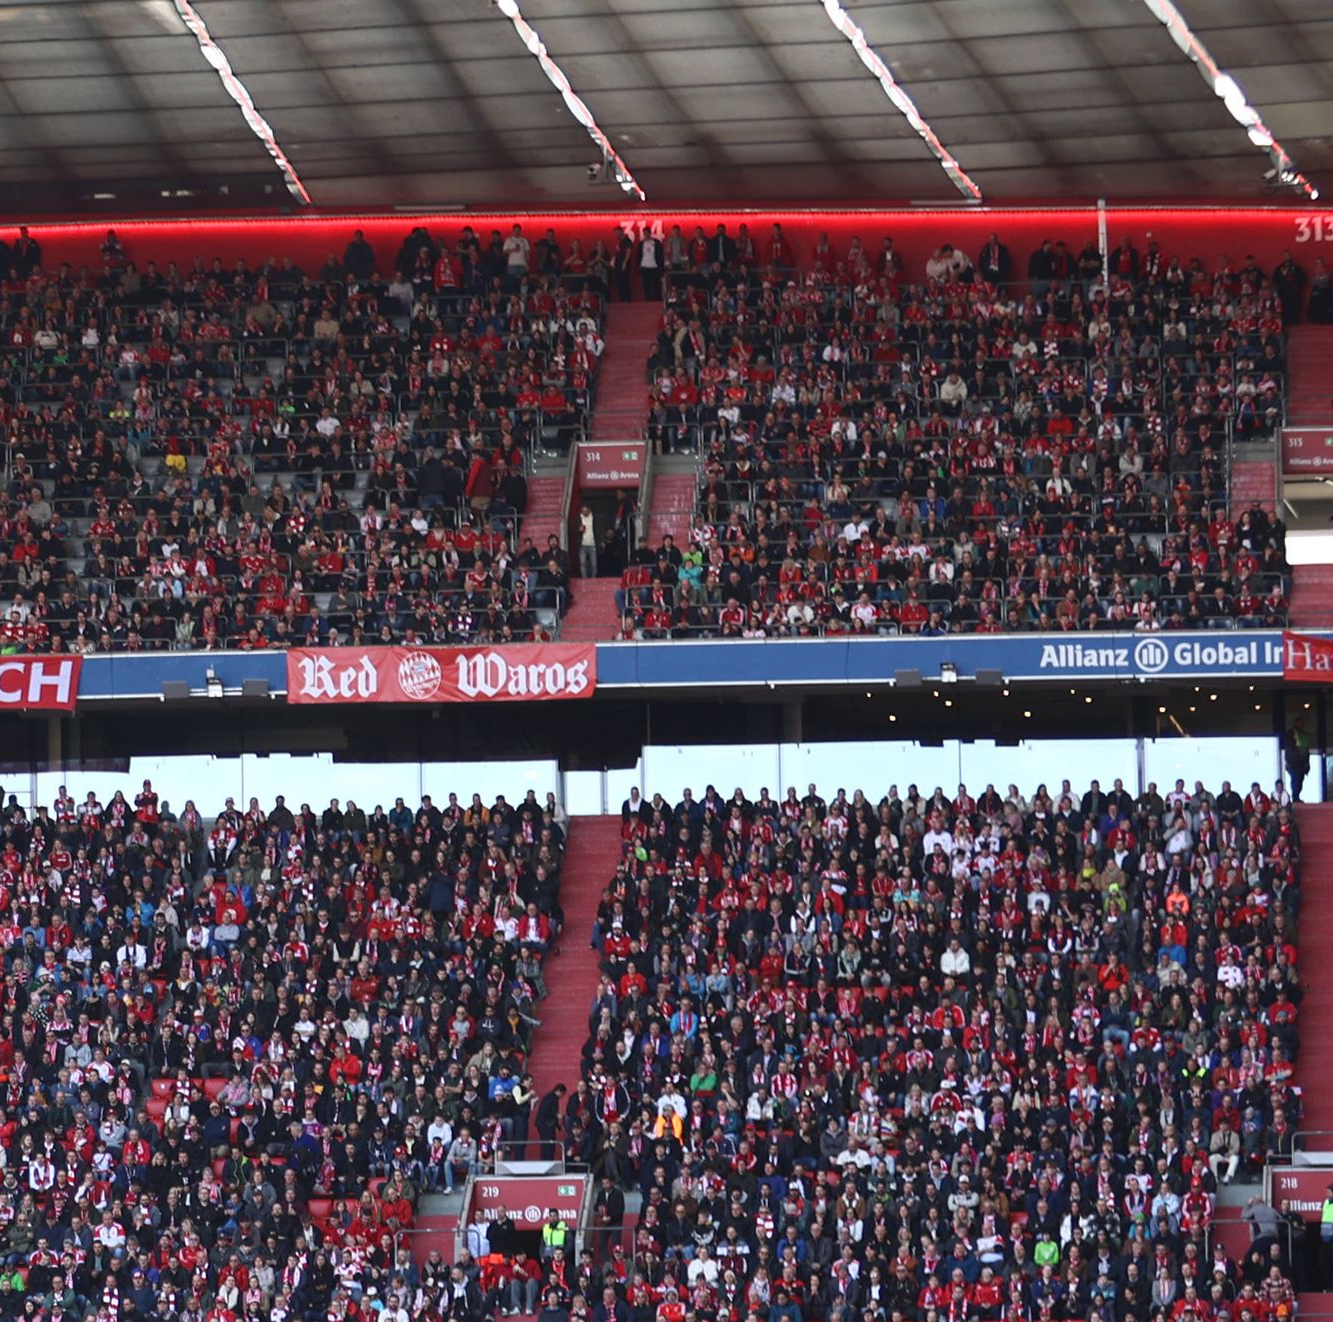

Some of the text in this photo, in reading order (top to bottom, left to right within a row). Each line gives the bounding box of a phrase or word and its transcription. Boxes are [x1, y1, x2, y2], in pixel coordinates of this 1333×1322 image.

[1040, 644, 1129, 668] Allianz
[1174, 642, 1256, 666] Global
[1286, 639, 1333, 671] Ha
[299, 655, 379, 698] Red
[483, 1186, 499, 1198] 219
[1290, 1200, 1321, 1211] llianz
